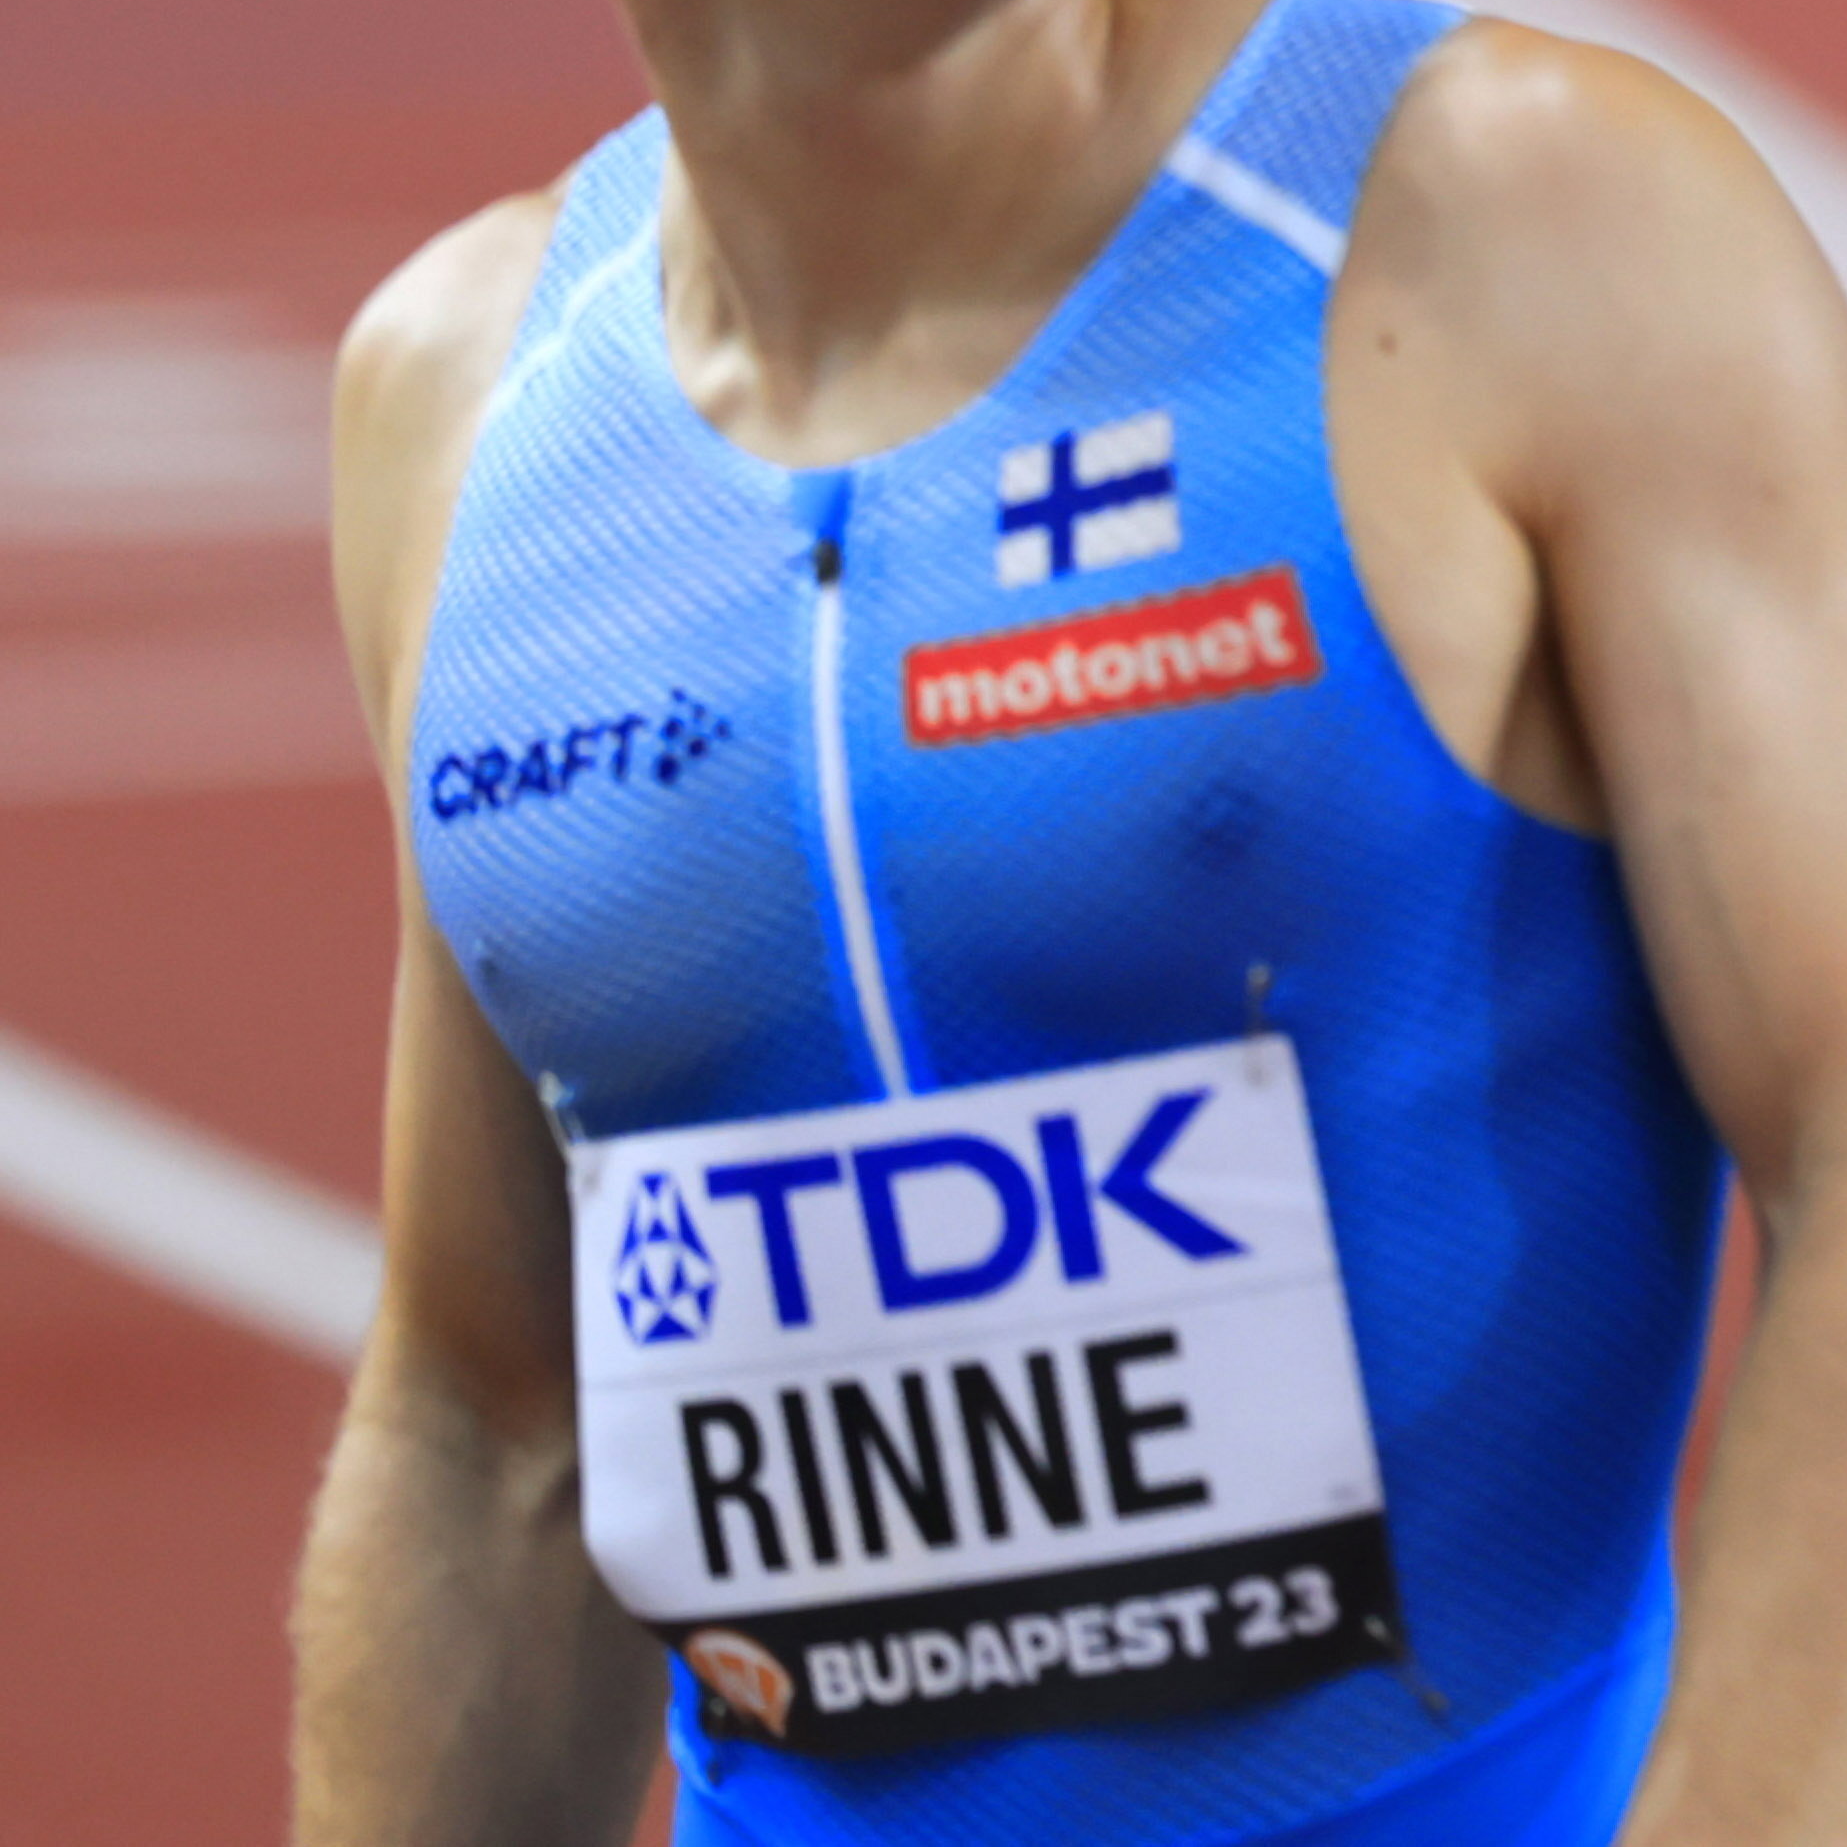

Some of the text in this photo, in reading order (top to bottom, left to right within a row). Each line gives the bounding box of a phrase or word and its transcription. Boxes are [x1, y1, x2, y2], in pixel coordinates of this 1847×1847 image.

[918, 601, 1294, 727] motonet
[430, 713, 645, 821] CRAFT
[706, 1088, 1252, 1329] TDK
[680, 1329, 1212, 1581] RINNE
[806, 1568, 1341, 1713] BUDAPEST 23
